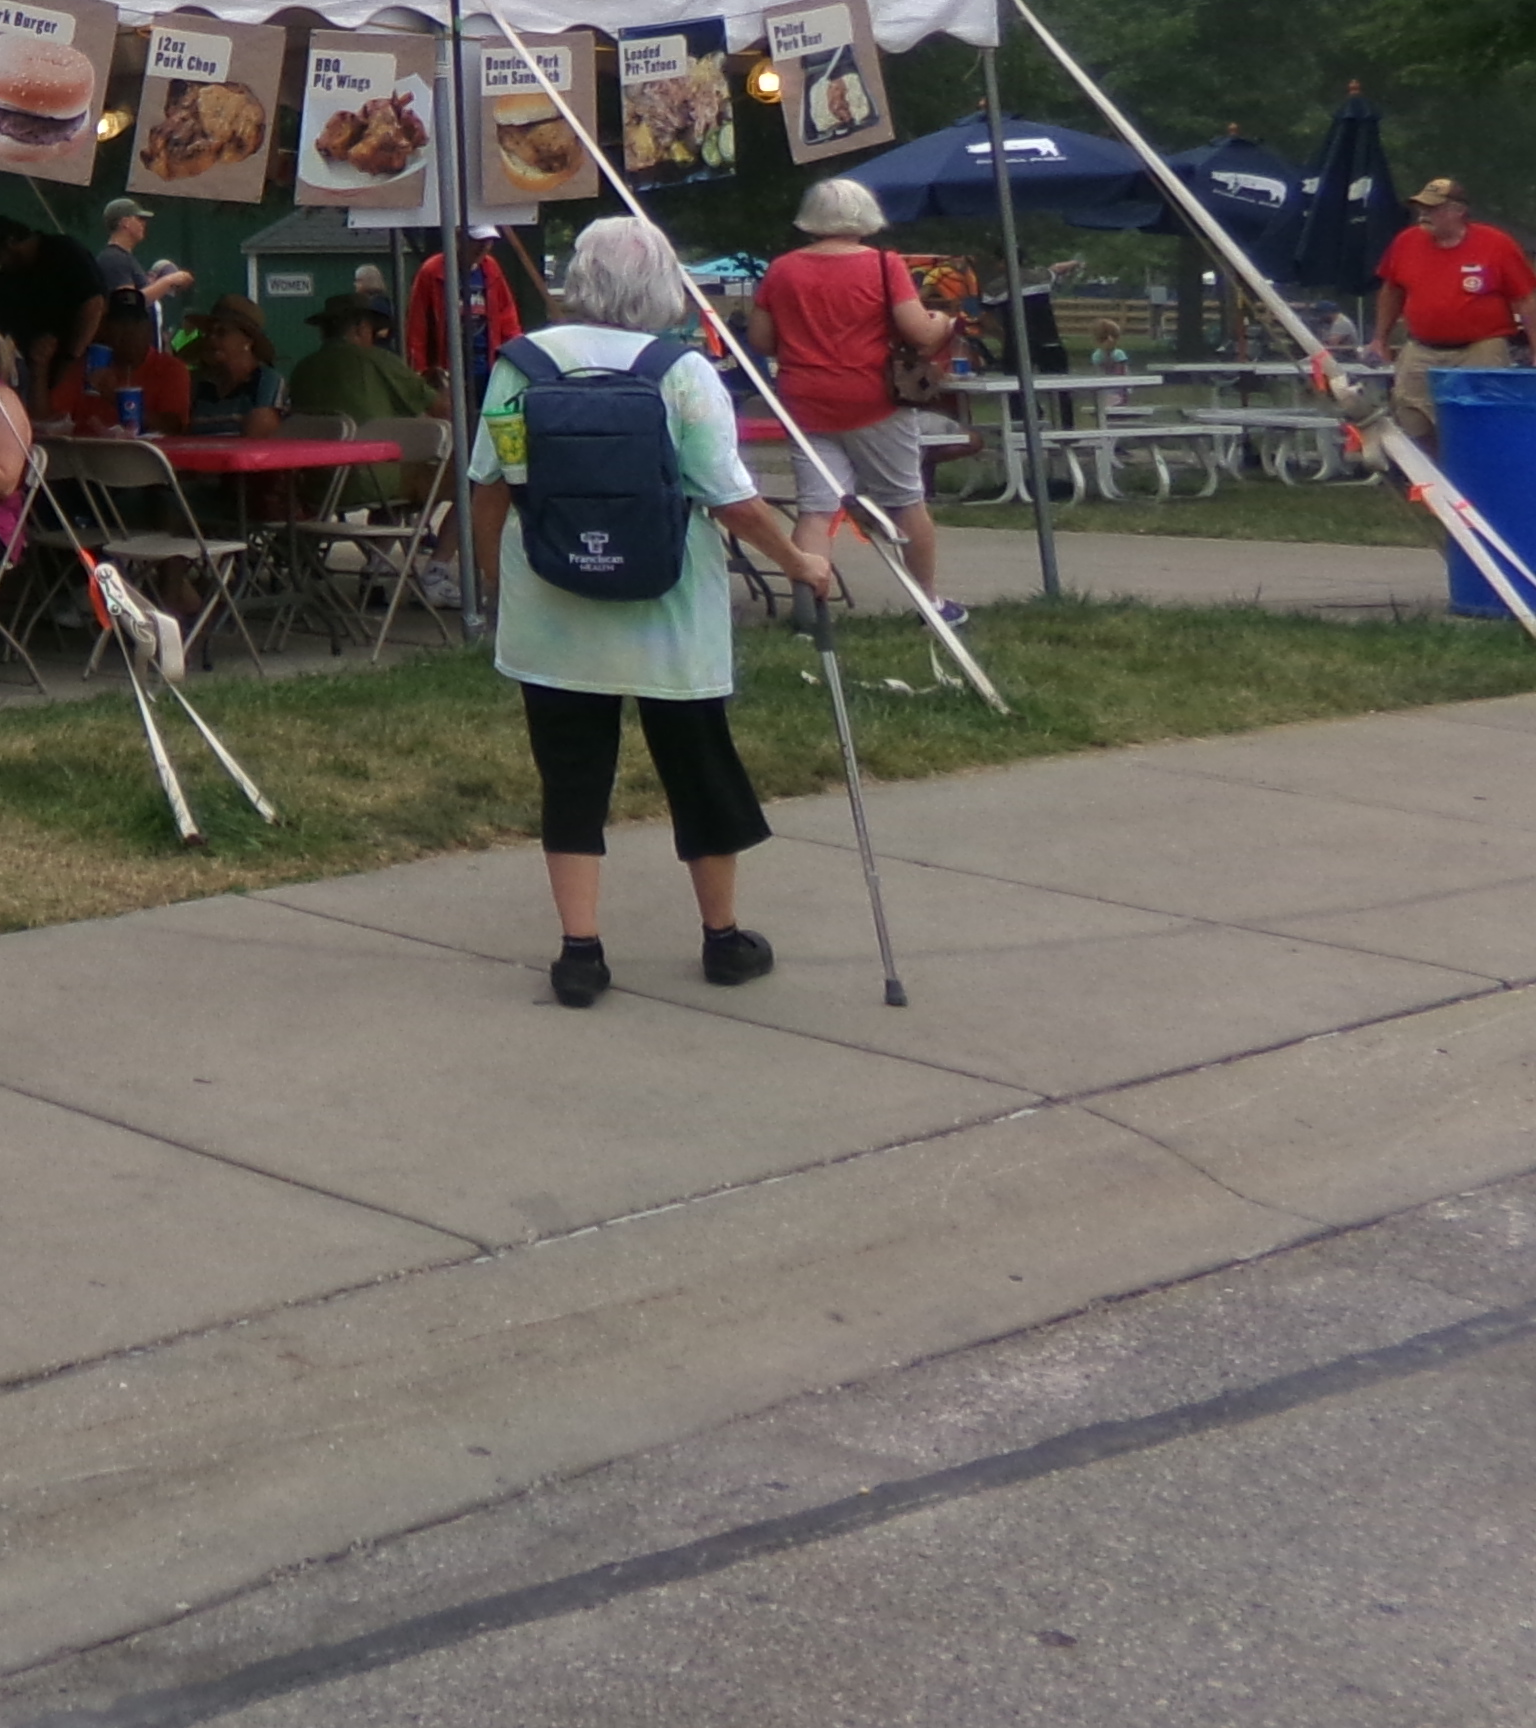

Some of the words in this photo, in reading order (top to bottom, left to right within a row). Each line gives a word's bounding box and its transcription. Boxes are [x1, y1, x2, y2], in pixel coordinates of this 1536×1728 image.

[14, 11, 58, 35] Burger
[157, 35, 186, 54] 12oz
[624, 43, 661, 61] Loaded
[154, 52, 184, 70] Pork
[187, 55, 217, 76] Chop
[315, 58, 341, 73] BBQ
[485, 56, 529, 71] Boneles
[536, 53, 559, 68] Pork
[313, 73, 334, 91] Pig
[336, 75, 371, 92] Wings
[485, 72, 508, 86] Loin
[270, 278, 309, 291] WOMEN
[569, 553, 624, 564] Franciscan
[580, 564, 615, 572] HEALTH
